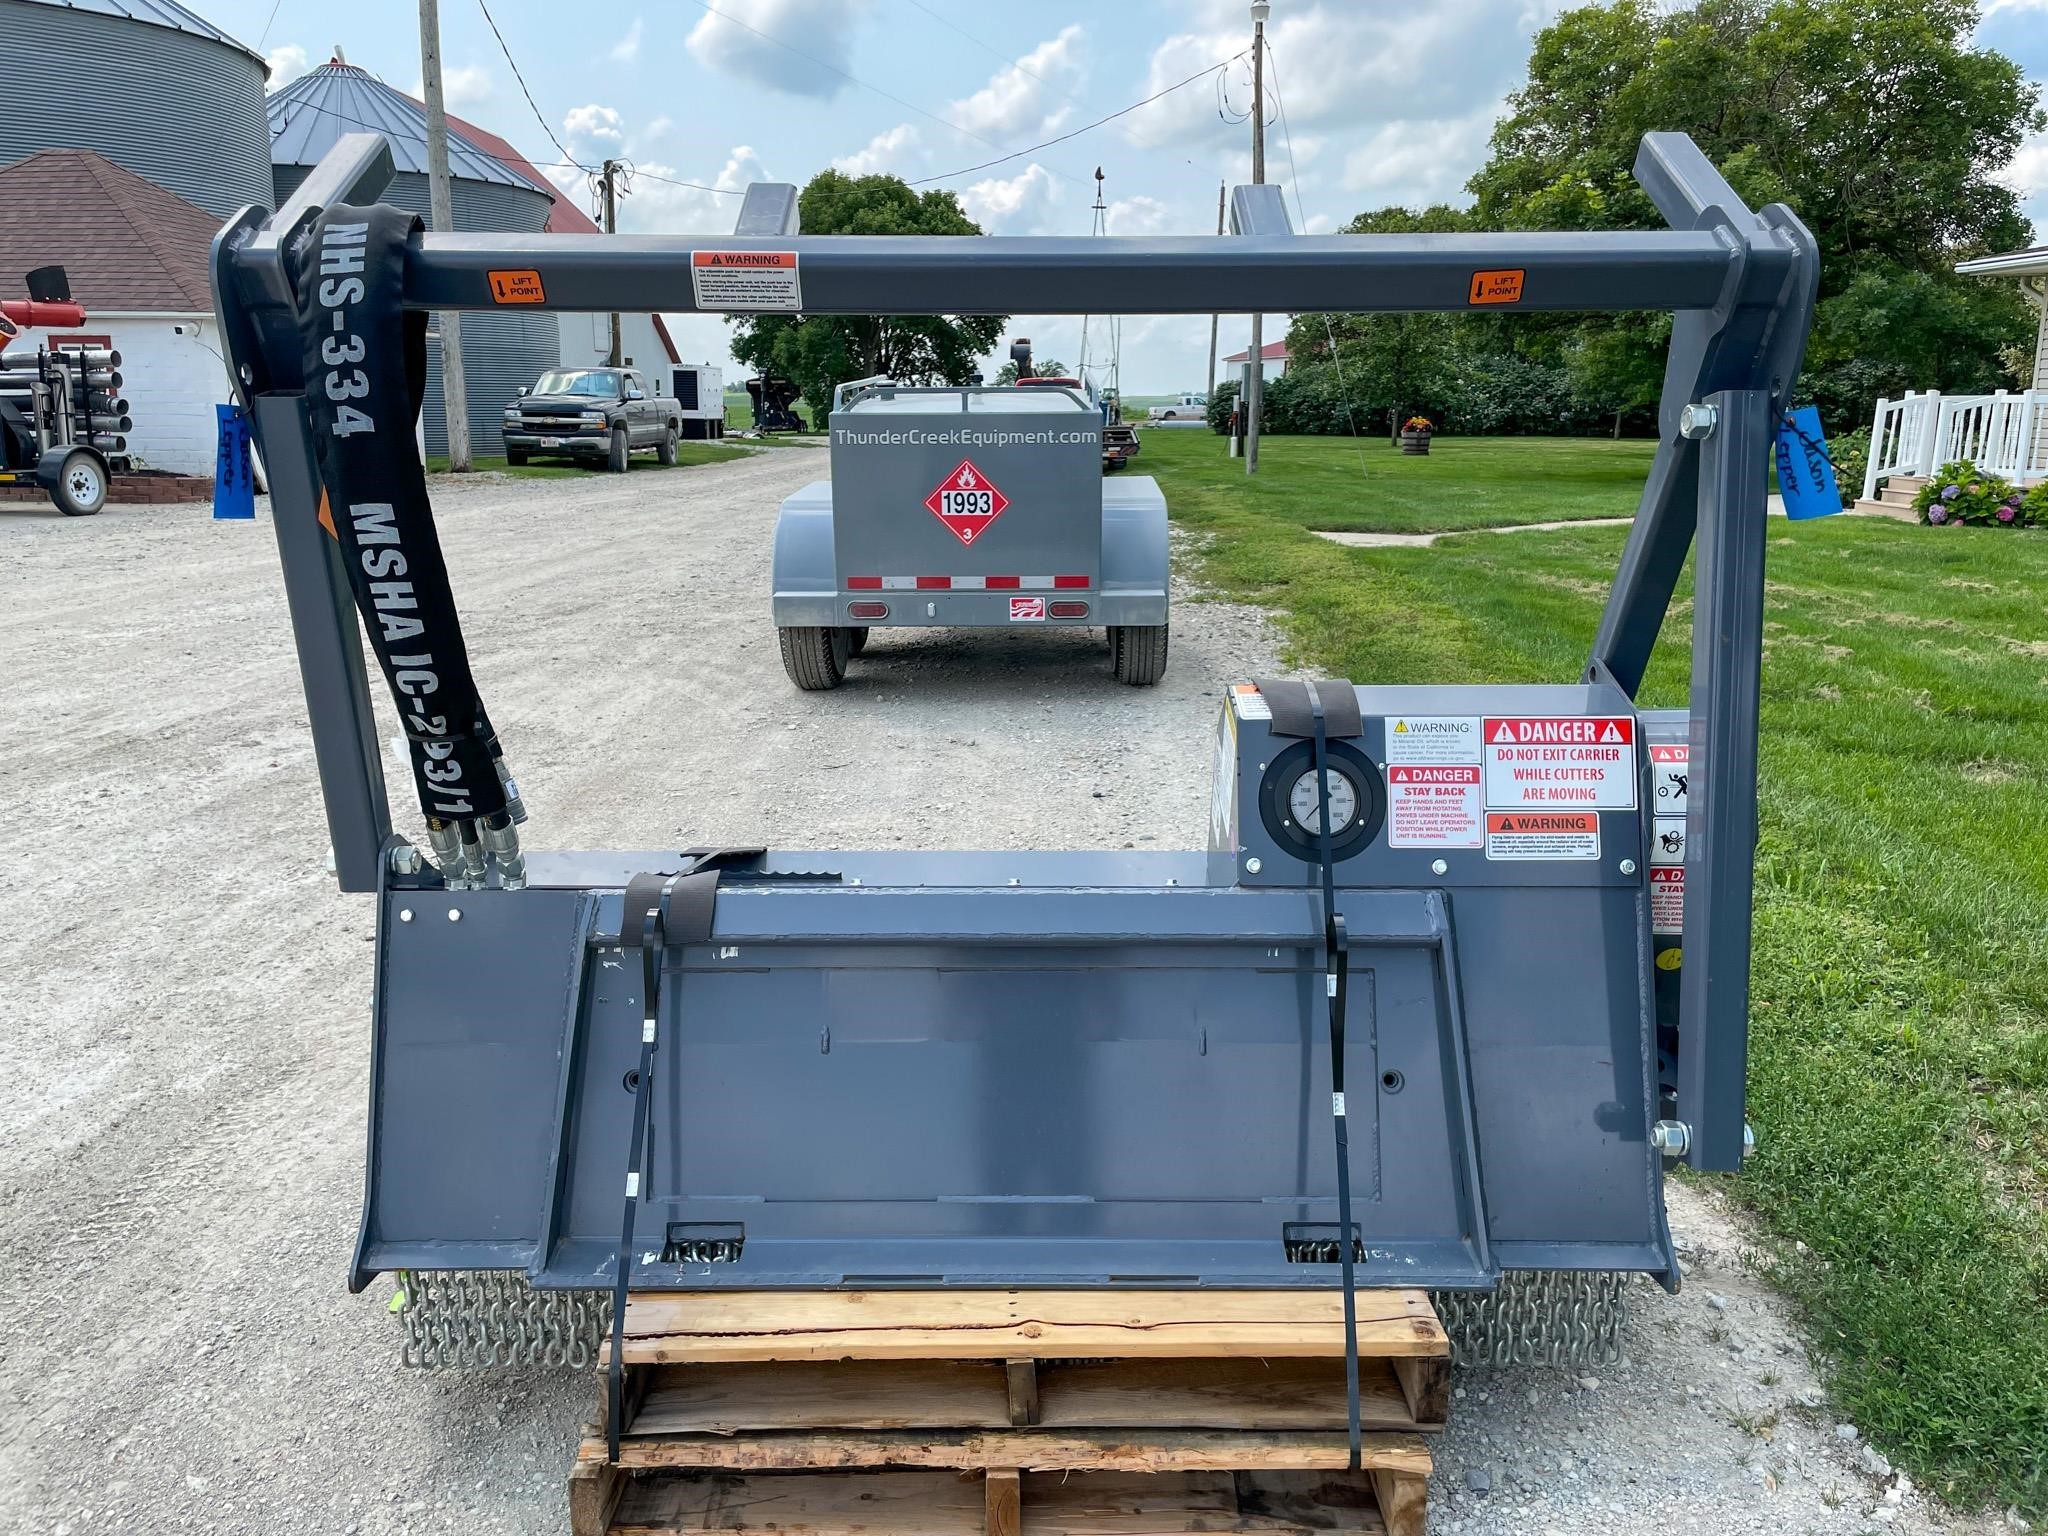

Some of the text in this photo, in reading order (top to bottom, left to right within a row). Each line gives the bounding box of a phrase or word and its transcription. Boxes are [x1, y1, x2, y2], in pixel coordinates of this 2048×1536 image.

[725, 255, 780, 264] WARNING
[1494, 277, 1516, 285] LIFT
[1488, 287, 1518, 295] POINT
[319, 222, 375, 438] NHS-334
[836, 430, 1097, 447] ThunderCreekEquipment.com
[1778, 428, 1800, 496] Lepper
[1800, 431, 1824, 493] Jason
[943, 492, 991, 514] 1993
[963, 528, 972, 539] 3
[350, 504, 473, 814] MSHA IC-293/1
[1410, 722, 1472, 733] WARNING:
[1519, 722, 1596, 742] DANGER
[1497, 748, 1620, 761] DO NOT EXIT CARRIER
[1413, 770, 1473, 781] DANGER
[1514, 768, 1604, 780] WHILE CUTTERS
[1404, 788, 1466, 796] STAY BACK
[1523, 788, 1596, 800] ARE MOVING
[1518, 818, 1586, 829] WARNING
